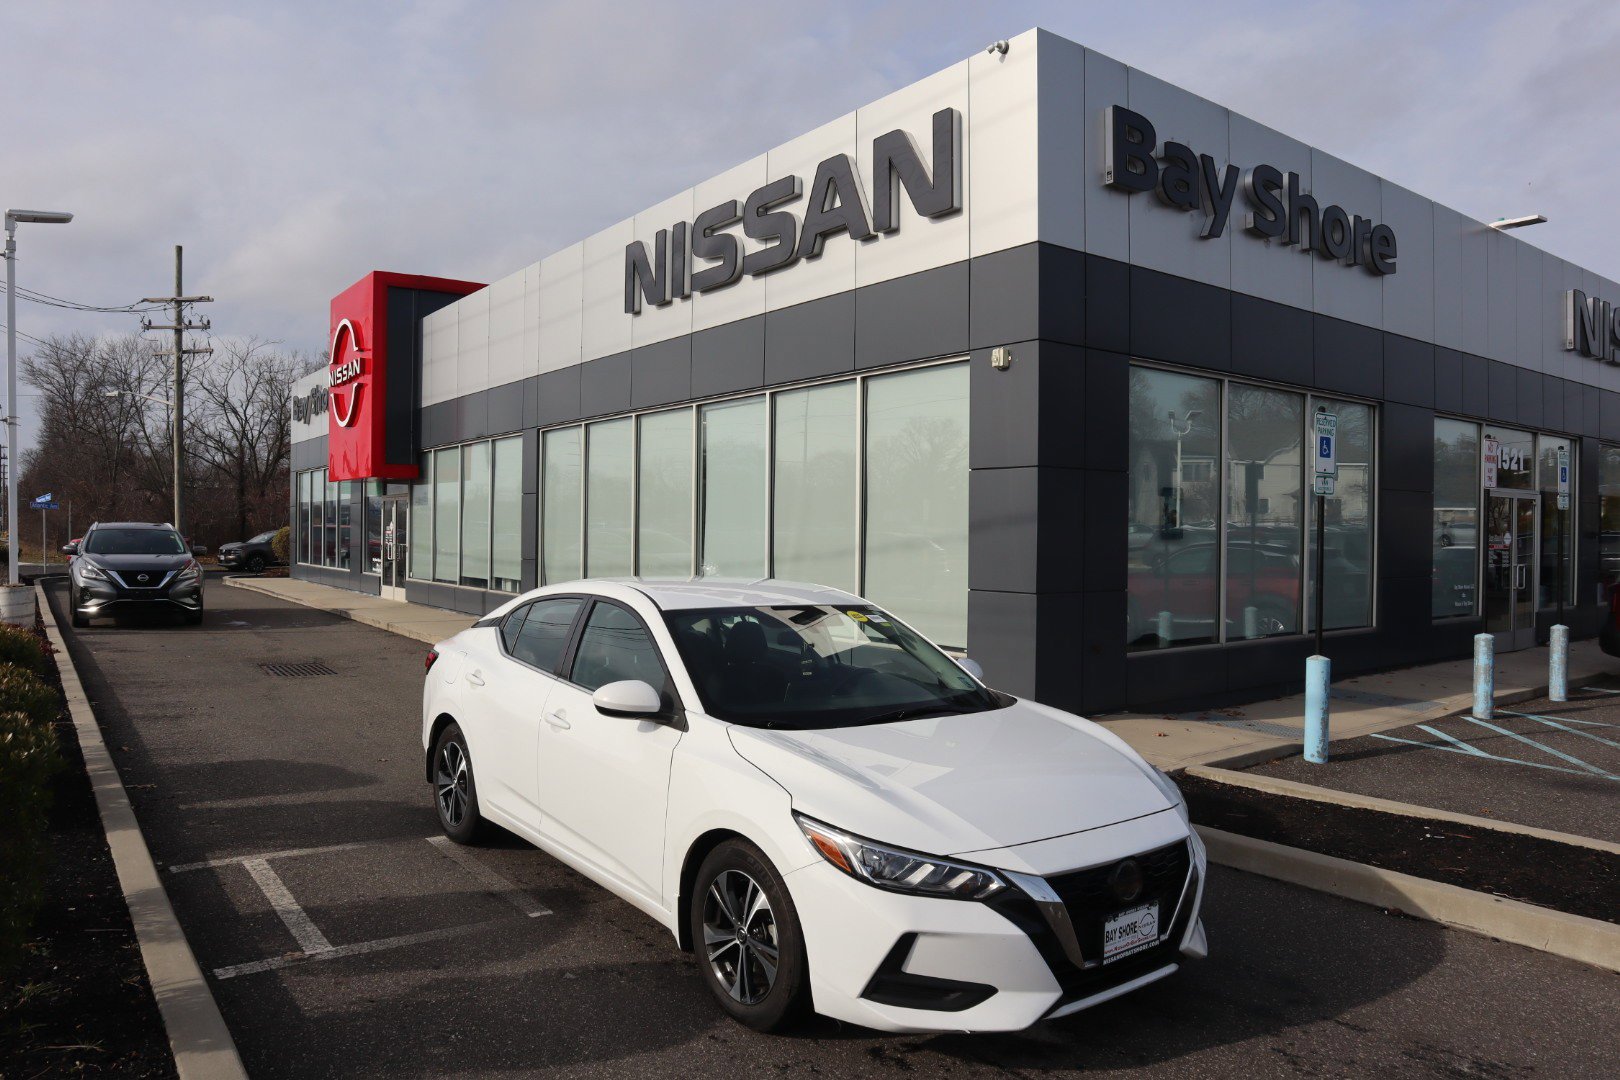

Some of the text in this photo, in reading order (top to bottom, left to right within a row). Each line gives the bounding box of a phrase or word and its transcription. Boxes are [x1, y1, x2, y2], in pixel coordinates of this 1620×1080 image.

[1104, 104, 1397, 274] Bay Shore
[624, 107, 962, 314] NISSAN
[1567, 289, 1620, 362] NI
[328, 357, 361, 387] NISSAN
[293, 395, 311, 425] Bay
[1318, 427, 1335, 436] PARKING
[1496, 446, 1524, 471] 1521
[1105, 928, 1118, 943] BAY
[1119, 921, 1138, 940] SHORE
